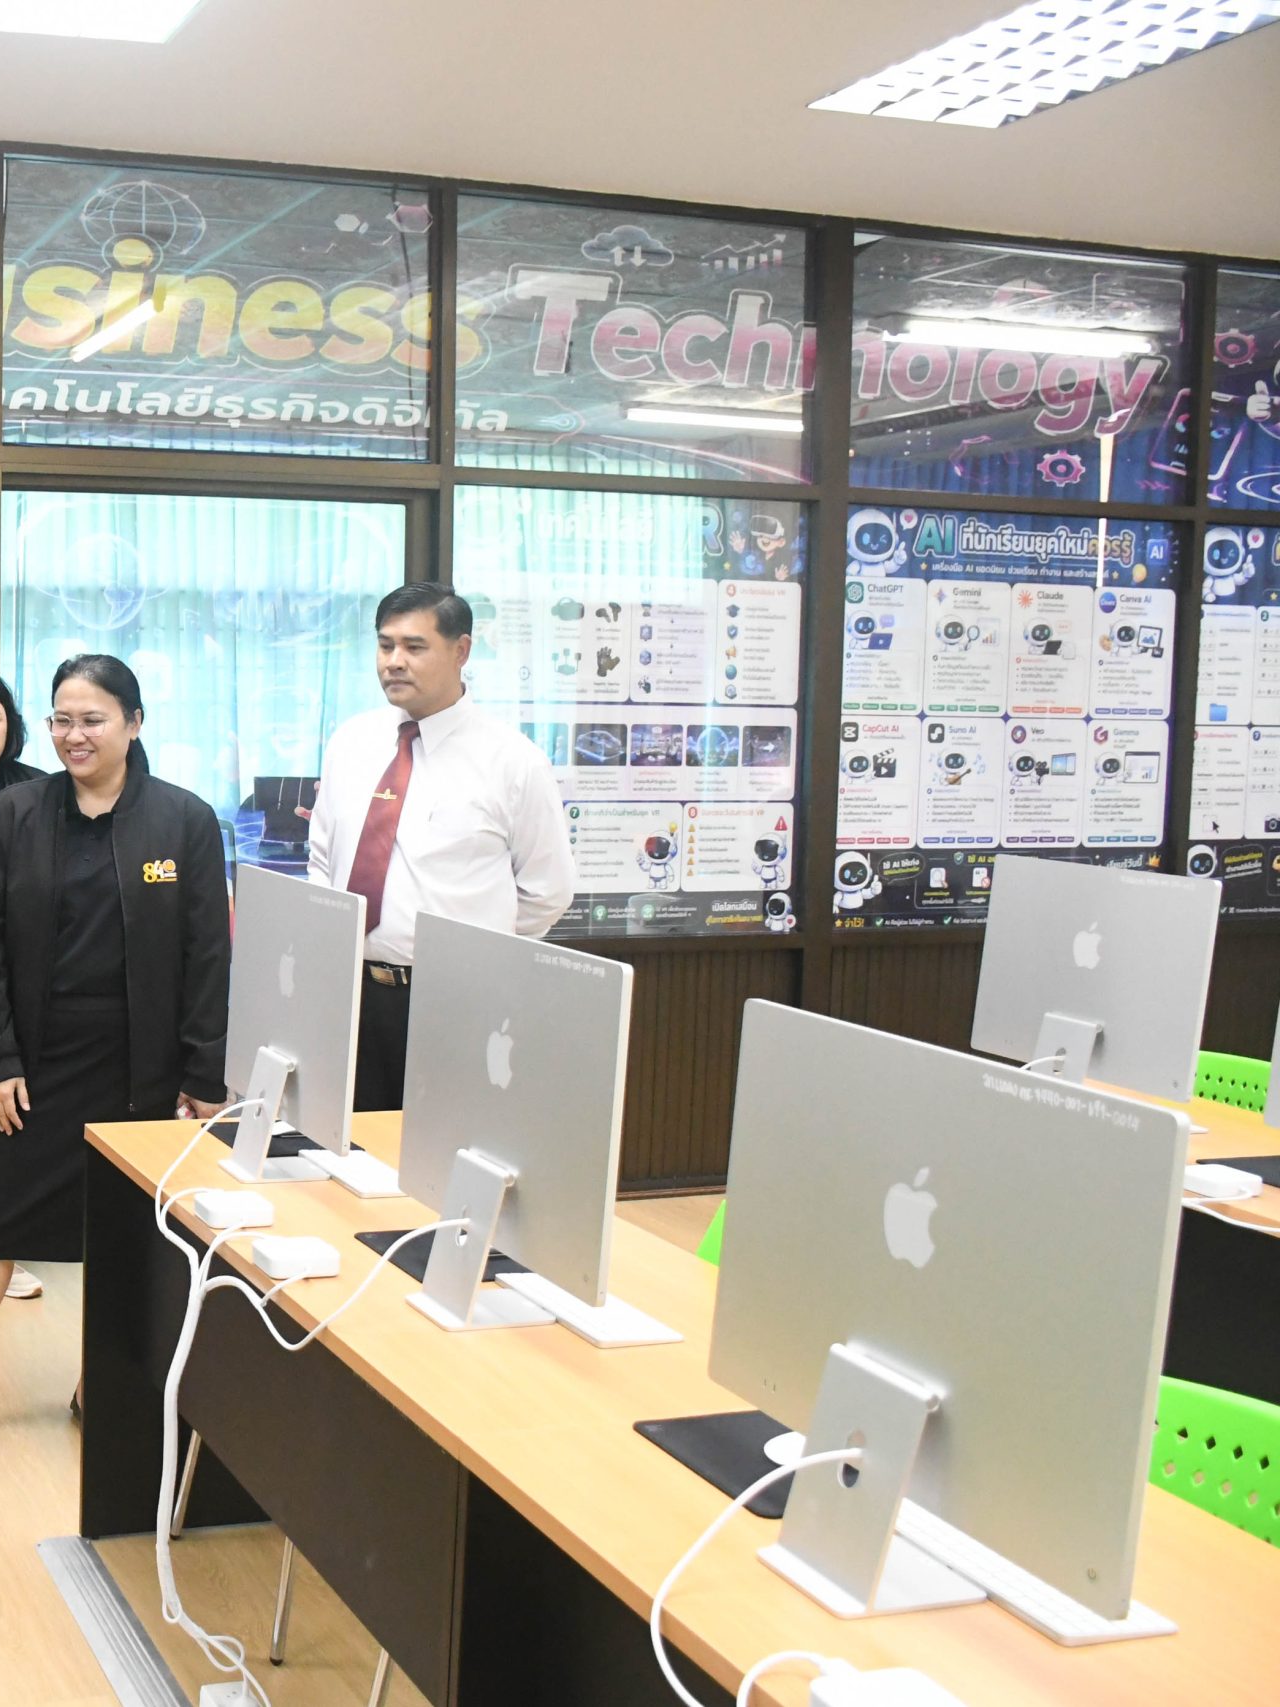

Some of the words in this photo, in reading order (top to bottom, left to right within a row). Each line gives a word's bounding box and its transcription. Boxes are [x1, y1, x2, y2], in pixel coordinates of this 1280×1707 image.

[517, 268, 1161, 437] Technology
[915, 515, 956, 556] AI
[962, 520, 1133, 565] ที่นักเรียนยุคใหม่ควรรู้
[1150, 545, 1164, 559] AI
[867, 583, 904, 594] ChatGPT
[953, 587, 982, 597] Gemini
[1037, 591, 1064, 600] Claude
[1120, 594, 1142, 603] Canva
[1143, 595, 1152, 603] AI
[862, 724, 890, 734] CapCut
[891, 724, 900, 733] AI
[949, 725, 968, 734] Suno
[968, 725, 977, 734] AI
[1031, 727, 1045, 735] Veo
